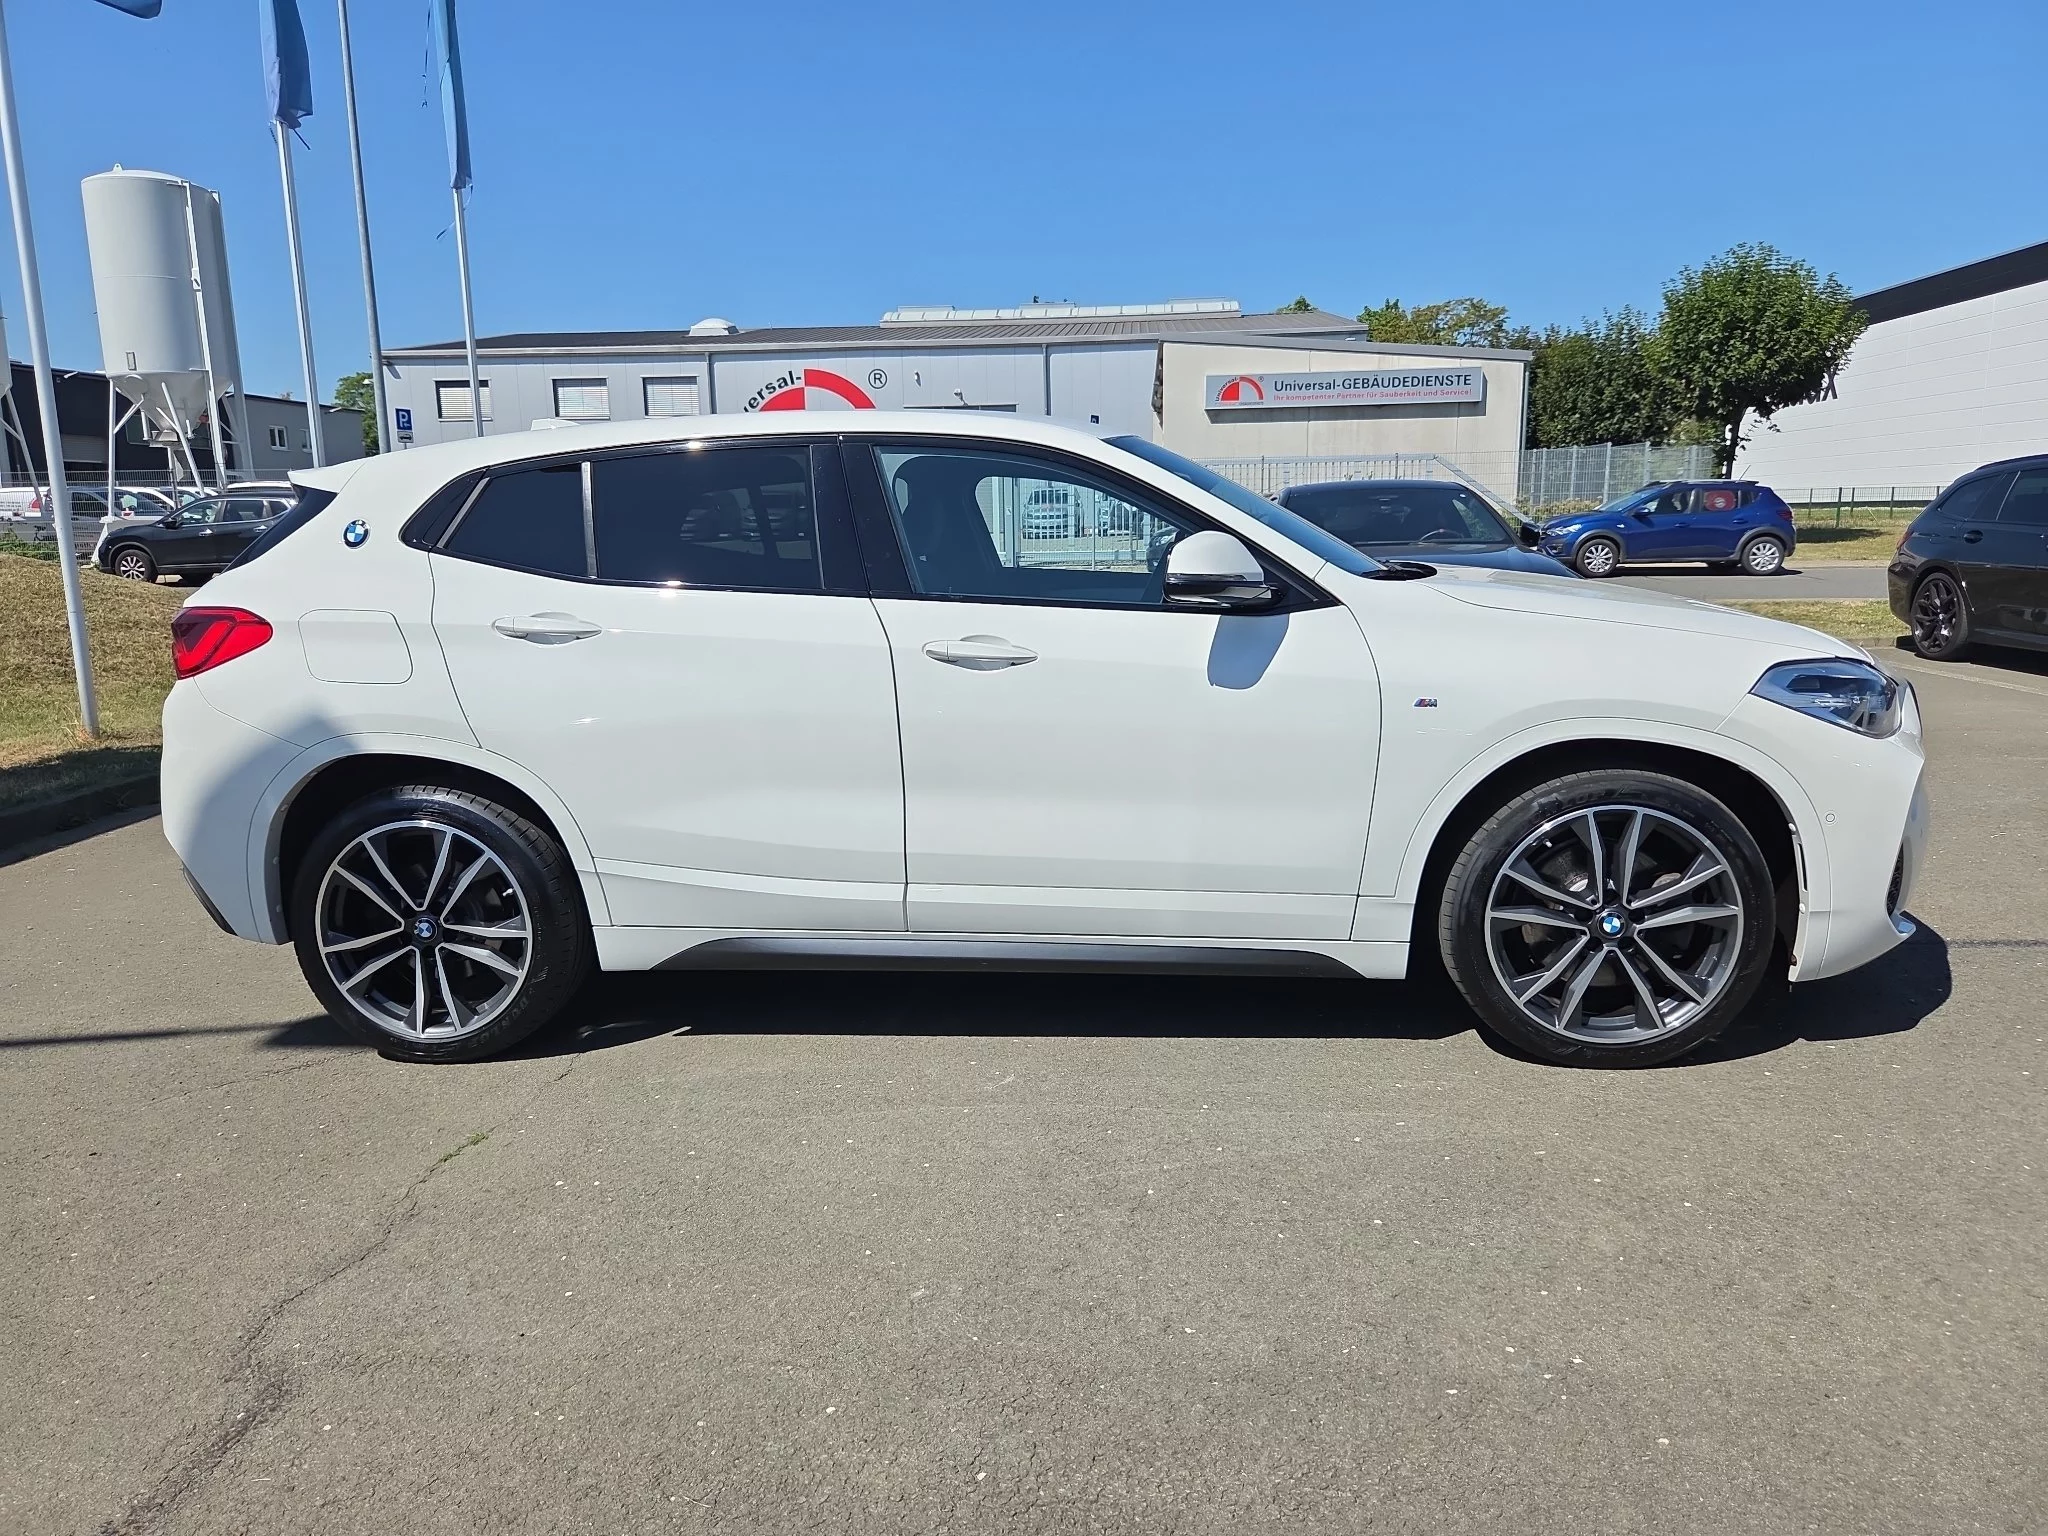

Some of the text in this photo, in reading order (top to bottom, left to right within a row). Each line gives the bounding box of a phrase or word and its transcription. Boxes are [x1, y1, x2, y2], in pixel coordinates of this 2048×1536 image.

[1274, 374, 1472, 392] Universal-GEBÄUDEDIENSTE
[1286, 393, 1335, 401] kompetenter
[1336, 392, 1364, 400] Partner
[1366, 391, 1377, 399] für
[1379, 390, 1421, 398] Sauberkeit
[1423, 389, 1438, 397] und
[1440, 388, 1472, 396] Service!
[399, 411, 409, 428] P
